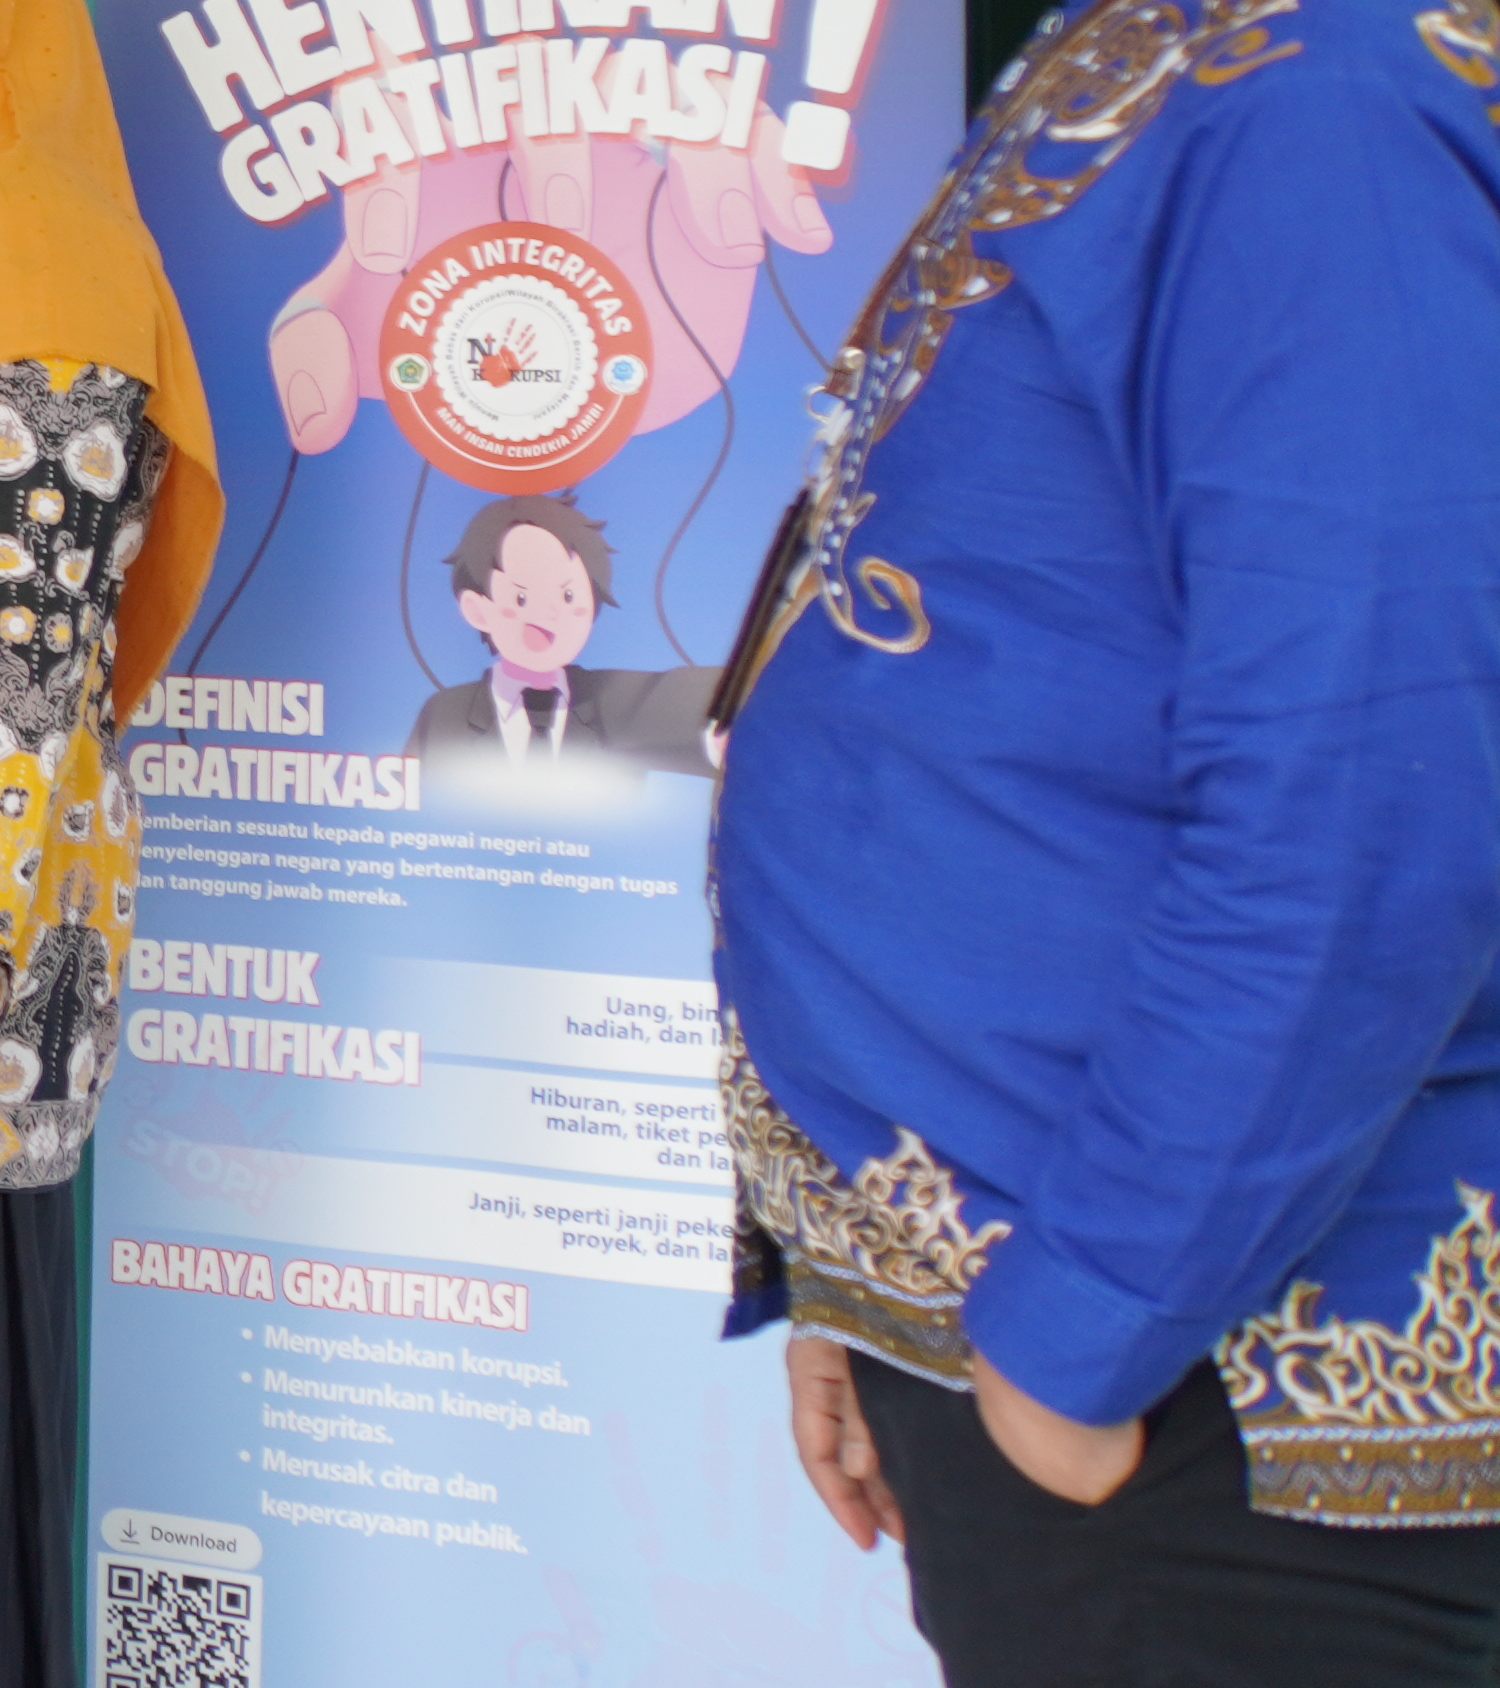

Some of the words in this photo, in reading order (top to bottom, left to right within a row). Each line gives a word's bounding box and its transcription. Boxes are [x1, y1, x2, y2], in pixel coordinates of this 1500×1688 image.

[219, 37, 767, 223] GRATIFIKASI
[399, 257, 470, 337] ZONA
[469, 237, 632, 336] INTEGRITAS
[436, 407, 465, 436] MAN
[464, 429, 502, 455] INSAN
[506, 434, 571, 458] CENDEKIA
[570, 402, 604, 440] JAMBI
[131, 676, 324, 736] DEFINISI
[129, 742, 420, 811] GRATIFIKASI
[143, 813, 232, 835] emberian
[236, 821, 308, 839] sesuatu
[312, 823, 385, 845] kepada
[390, 831, 475, 850] pegawai
[479, 836, 542, 856] negeri
[546, 840, 590, 857] atau
[169, 875, 262, 900] tanggung
[265, 880, 324, 901] jawab
[328, 887, 408, 907] mereka.
[275, 854, 341, 874] negara
[345, 860, 396, 880] yang
[399, 858, 535, 887] bertentangan
[539, 869, 616, 893] dengan
[619, 876, 678, 898] tugas
[129, 938, 321, 1006] BENTUK
[566, 1015, 650, 1042] hadiah,
[659, 1025, 702, 1045] dan
[606, 997, 672, 1024] Uang,
[682, 1002, 719, 1022] bin
[127, 1008, 421, 1086] GRATIFIKASI
[531, 1086, 625, 1115] Hiburan,
[635, 1102, 715, 1122] seperti
[546, 1115, 627, 1139] malam,
[635, 1121, 690, 1143] tiket
[698, 1130, 728, 1148] pe
[657, 1147, 701, 1168] dan
[469, 1192, 526, 1219] Janji,
[533, 1204, 609, 1225] seperti
[616, 1210, 667, 1236] janji
[676, 1216, 734, 1238] peke
[562, 1231, 647, 1256] proyek,
[656, 1238, 699, 1259] dan
[111, 1238, 275, 1301] BAHAYA
[282, 1259, 529, 1332] GRATIFIKASI
[264, 1324, 455, 1373] Menyebabkan
[461, 1347, 569, 1388] korupsi.
[262, 1405, 394, 1445] integritas.
[263, 1368, 435, 1413] Menurunkan
[440, 1389, 533, 1431] kinerja
[538, 1405, 591, 1436] dan
[262, 1448, 375, 1487] Merusak
[380, 1465, 440, 1495] citra
[445, 1472, 498, 1503] dan
[151, 1525, 236, 1552] Download
[261, 1491, 429, 1539] kepercayaan
[435, 1520, 528, 1555] publik.
